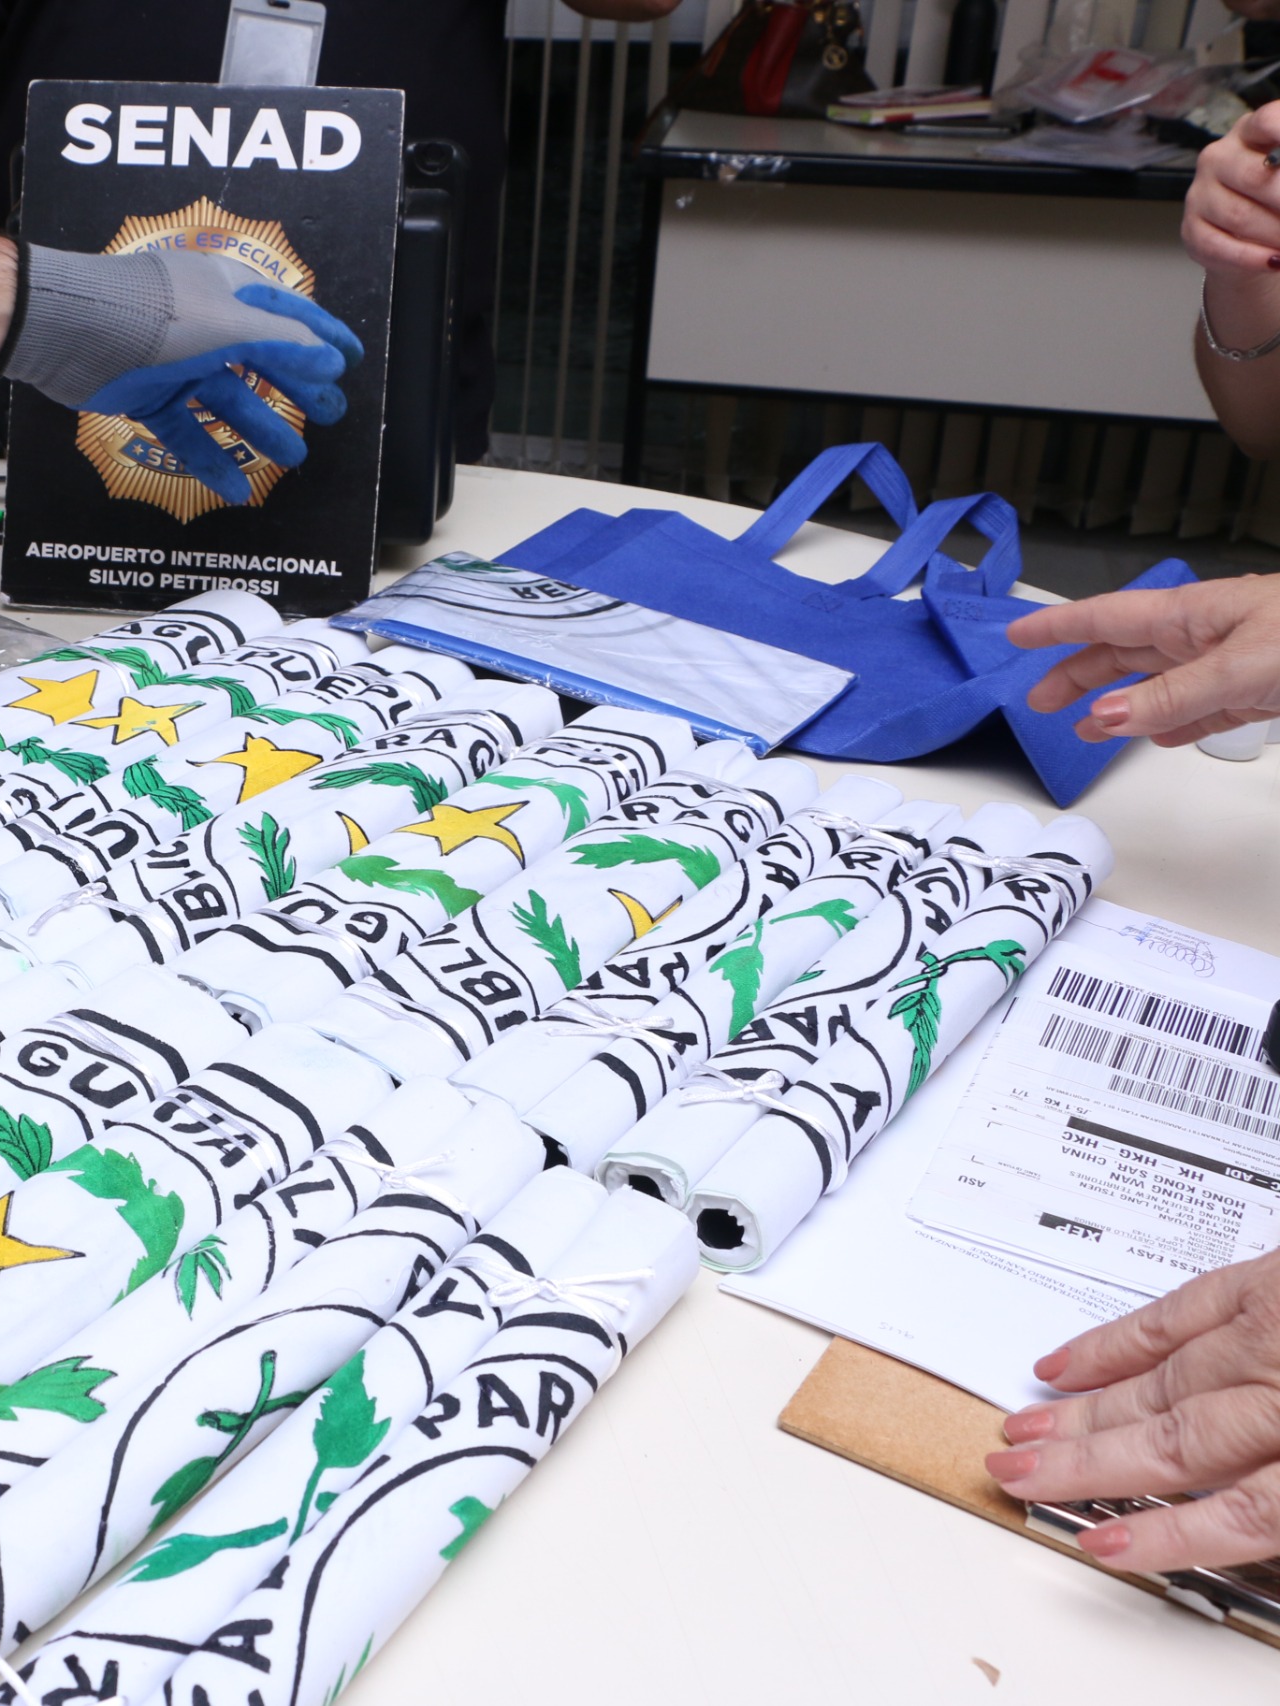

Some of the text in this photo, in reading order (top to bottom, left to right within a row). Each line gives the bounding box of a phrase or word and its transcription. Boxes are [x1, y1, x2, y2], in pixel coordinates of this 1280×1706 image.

[61, 103, 362, 171] SENAD
[196, 232, 290, 283] ESPECIAL
[145, 446, 184, 471] SE
[26, 541, 343, 577] AEROPUERTO INTERNACIONAL
[89, 568, 280, 596] SILVIO PETTIROSSI
[1043, 1096, 1060, 1107] KG
[1059, 1144, 1108, 1166] CHINA
[1059, 1129, 1204, 1182] HK HKG HKC
[956, 1172, 987, 1190] ASU
[1068, 1169, 1131, 1193] TERRITORIES
[1152, 1173, 1196, 1194] KONG
[1224, 1166, 1253, 1182] ADI
[1078, 1180, 1115, 1197] TSUEN
[1108, 1170, 1243, 1219] NA SHEUNG WAN
[1200, 1188, 1247, 1210] HONG
[1118, 1193, 1150, 1207] LANG
[1152, 1203, 1170, 1213] TAI
[1186, 1229, 1235, 1248] PARAGUAY
[1205, 1227, 1236, 1241] TANG
[1124, 1243, 1165, 1264] EASY
[1168, 1258, 1207, 1276] RESS
